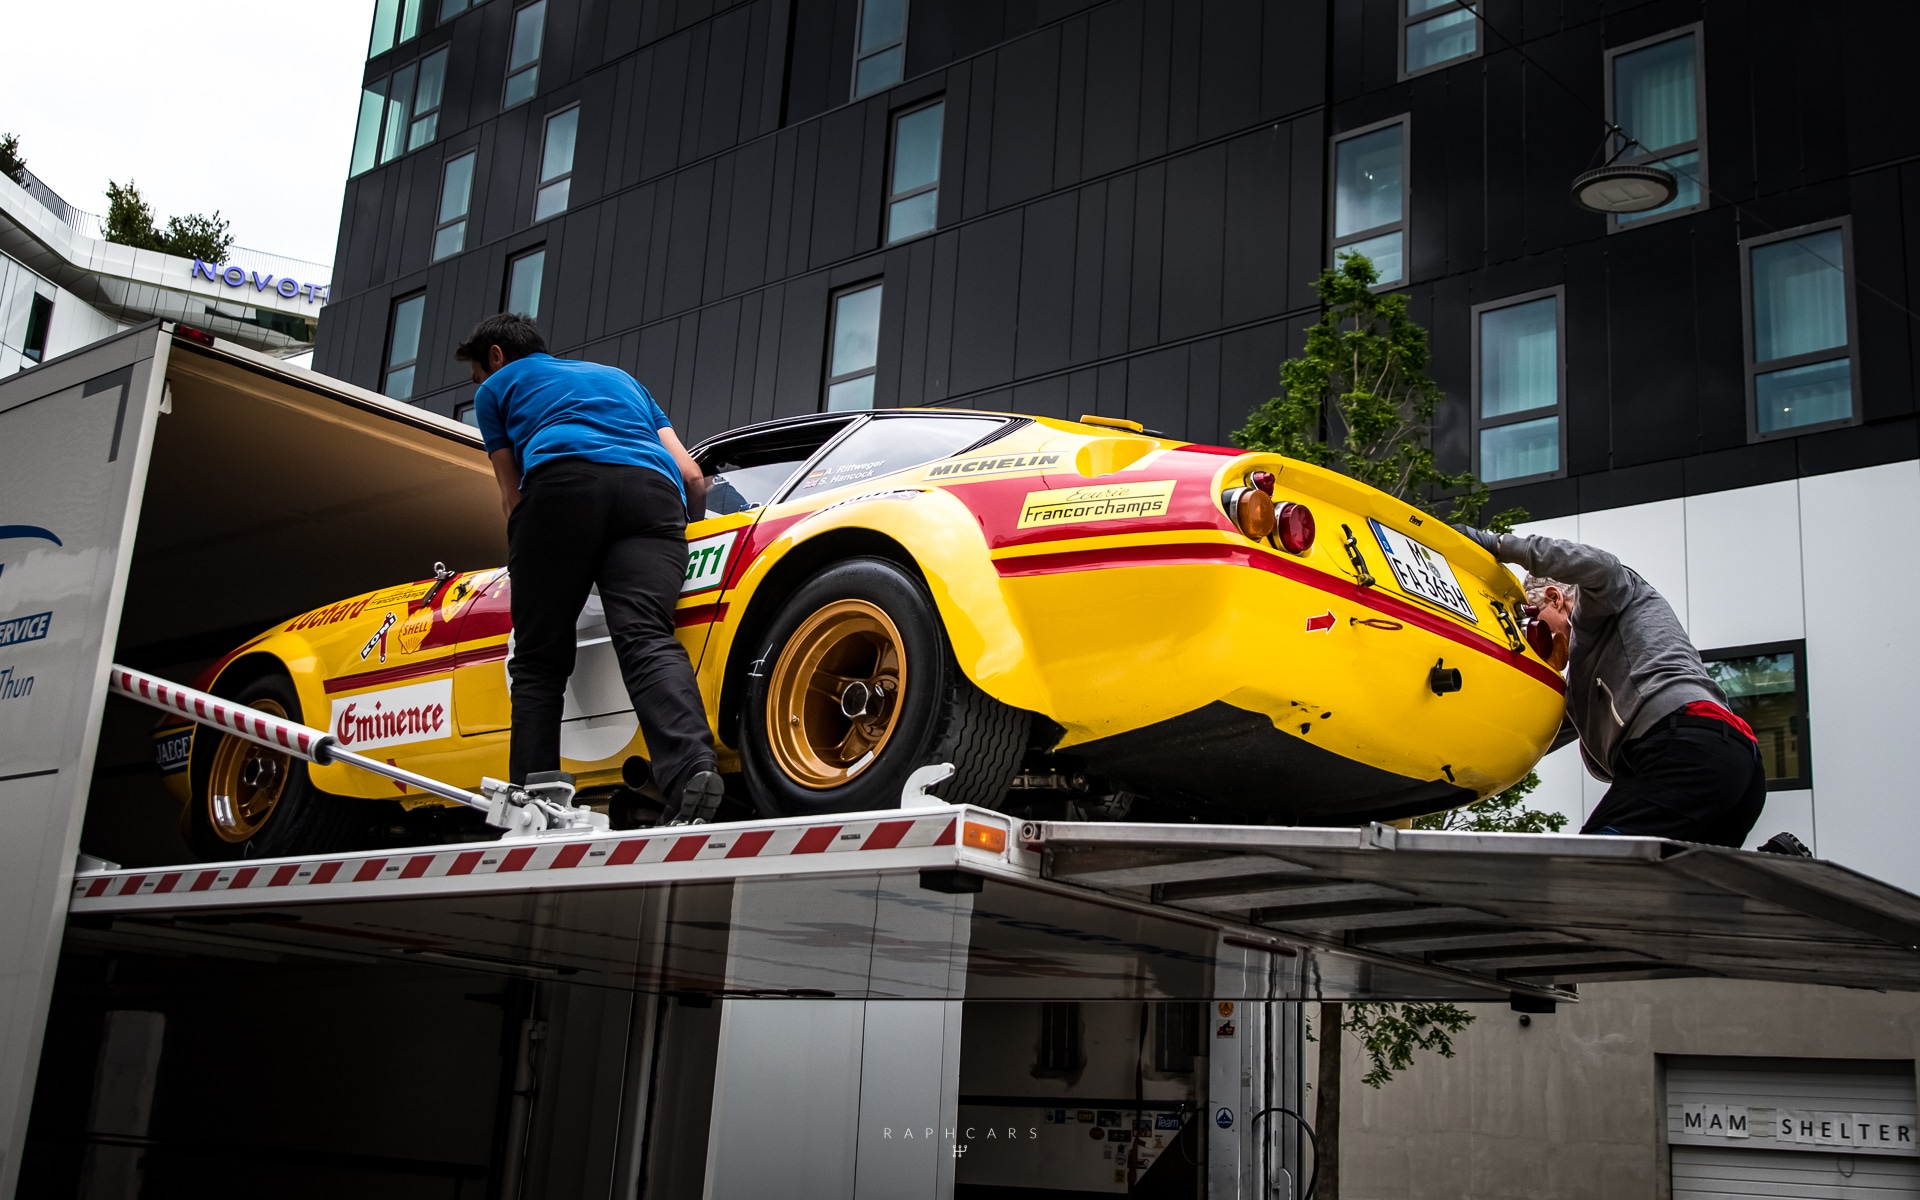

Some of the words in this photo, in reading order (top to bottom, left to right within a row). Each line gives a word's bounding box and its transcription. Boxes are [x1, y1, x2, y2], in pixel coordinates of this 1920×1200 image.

[191, 257, 330, 304] NOVOT
[830, 468, 875, 483] Hancock
[929, 454, 1060, 477] MICHELIN
[1066, 487, 1130, 502] Ecurie
[1024, 499, 1163, 523] Francorchamps
[1406, 539, 1429, 570] M
[361, 615, 396, 660] KONI
[402, 621, 429, 635] SHELL
[0, 666, 35, 700] Thun
[337, 700, 445, 746] Eminence
[155, 735, 194, 764] JAEGE
[1157, 1116, 1179, 1130] Team
[1684, 1112, 1747, 1131] MAM
[1781, 1118, 1911, 1142] SHELTER
